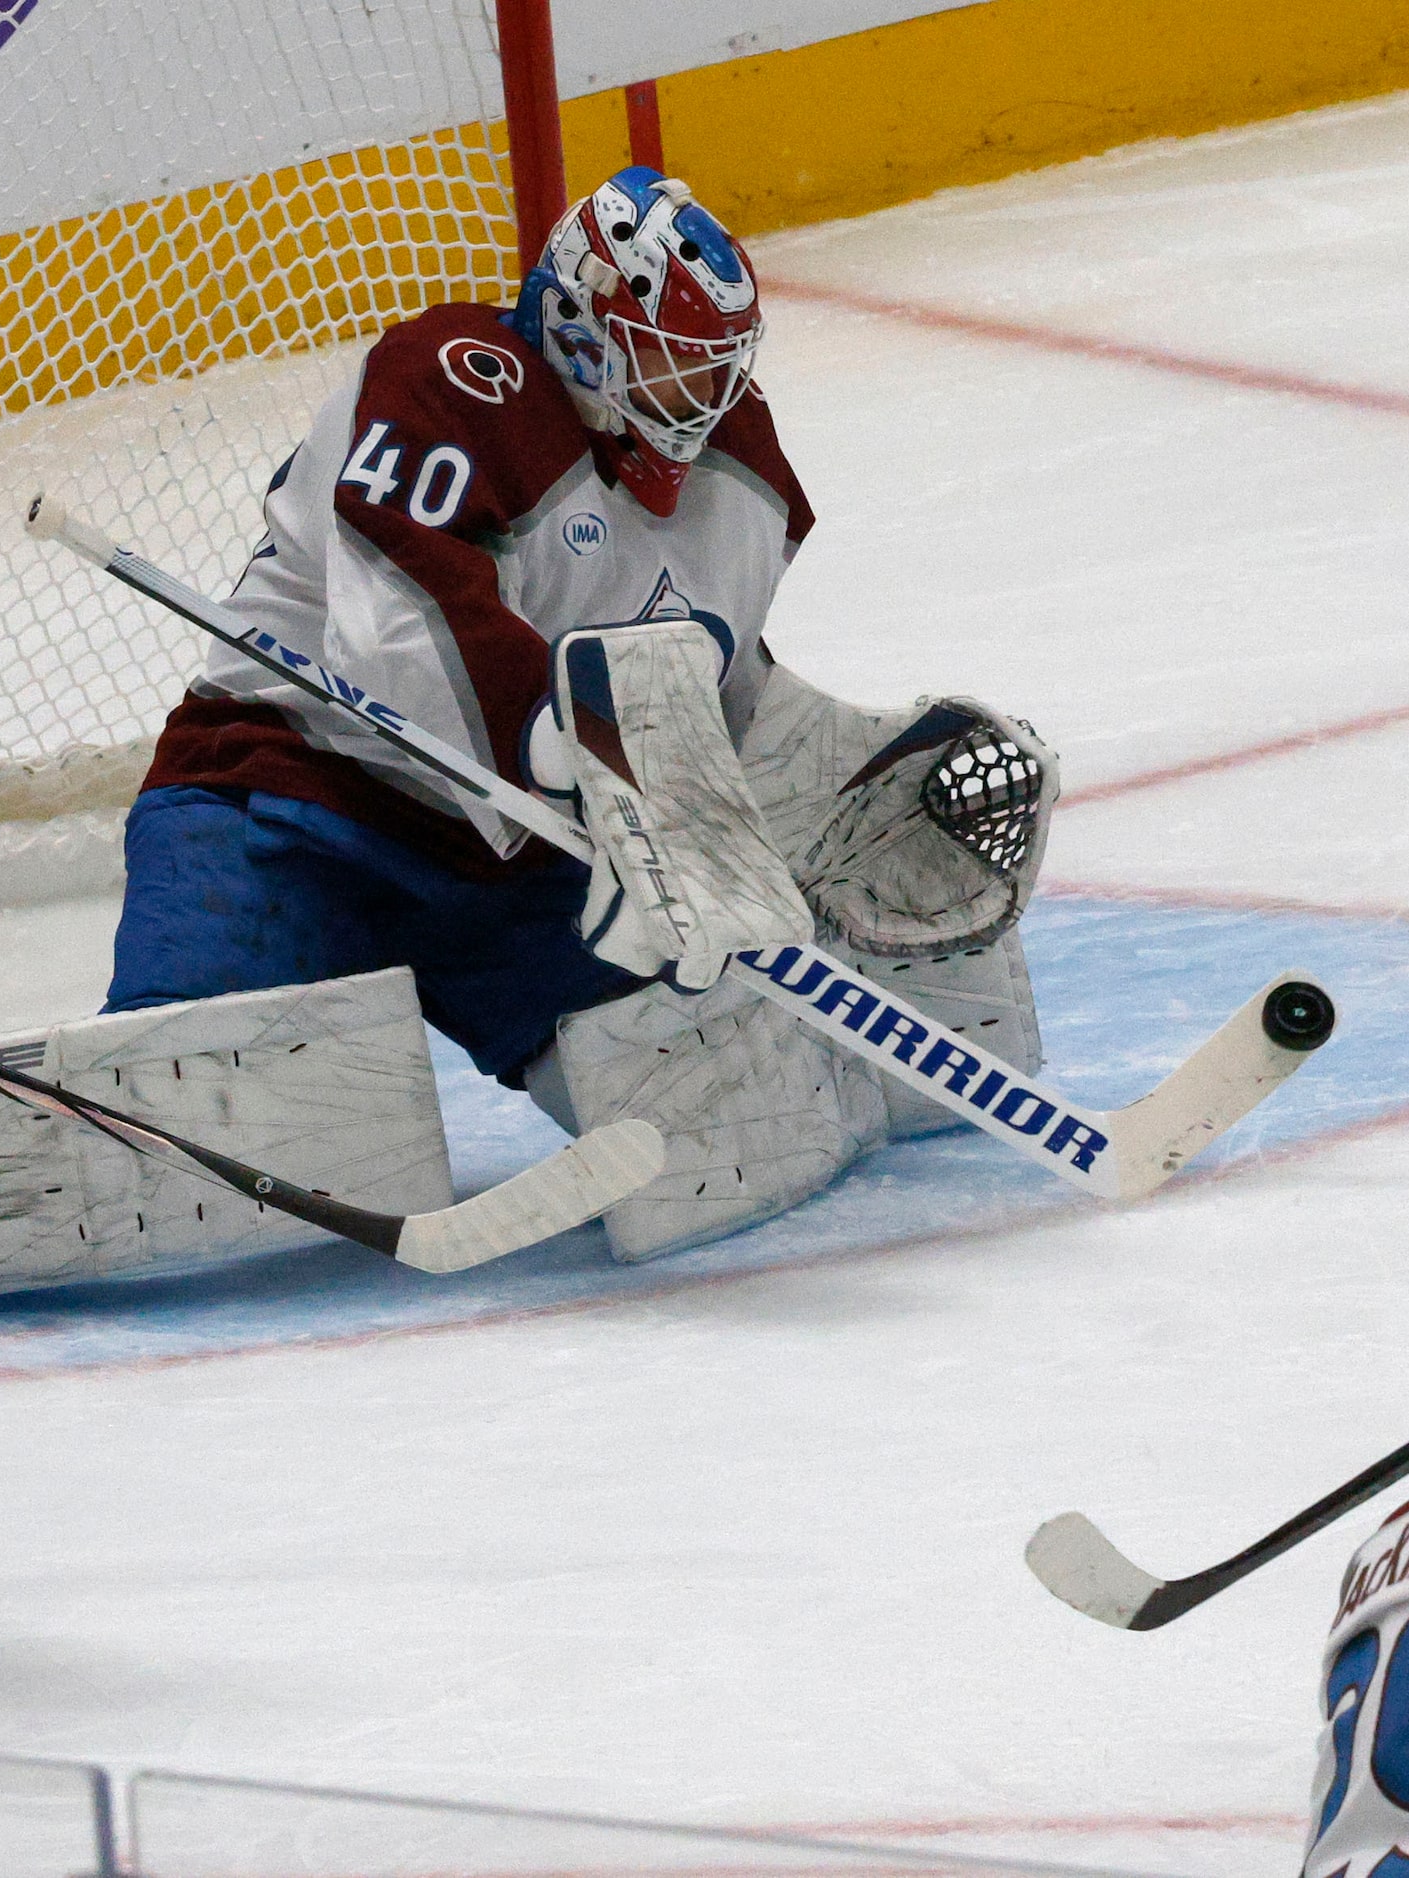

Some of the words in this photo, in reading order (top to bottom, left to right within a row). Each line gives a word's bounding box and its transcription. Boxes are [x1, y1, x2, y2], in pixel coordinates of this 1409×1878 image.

[339, 420, 475, 528] 40
[572, 523, 600, 544] IMA
[736, 945, 1110, 1175] WARRIOR
